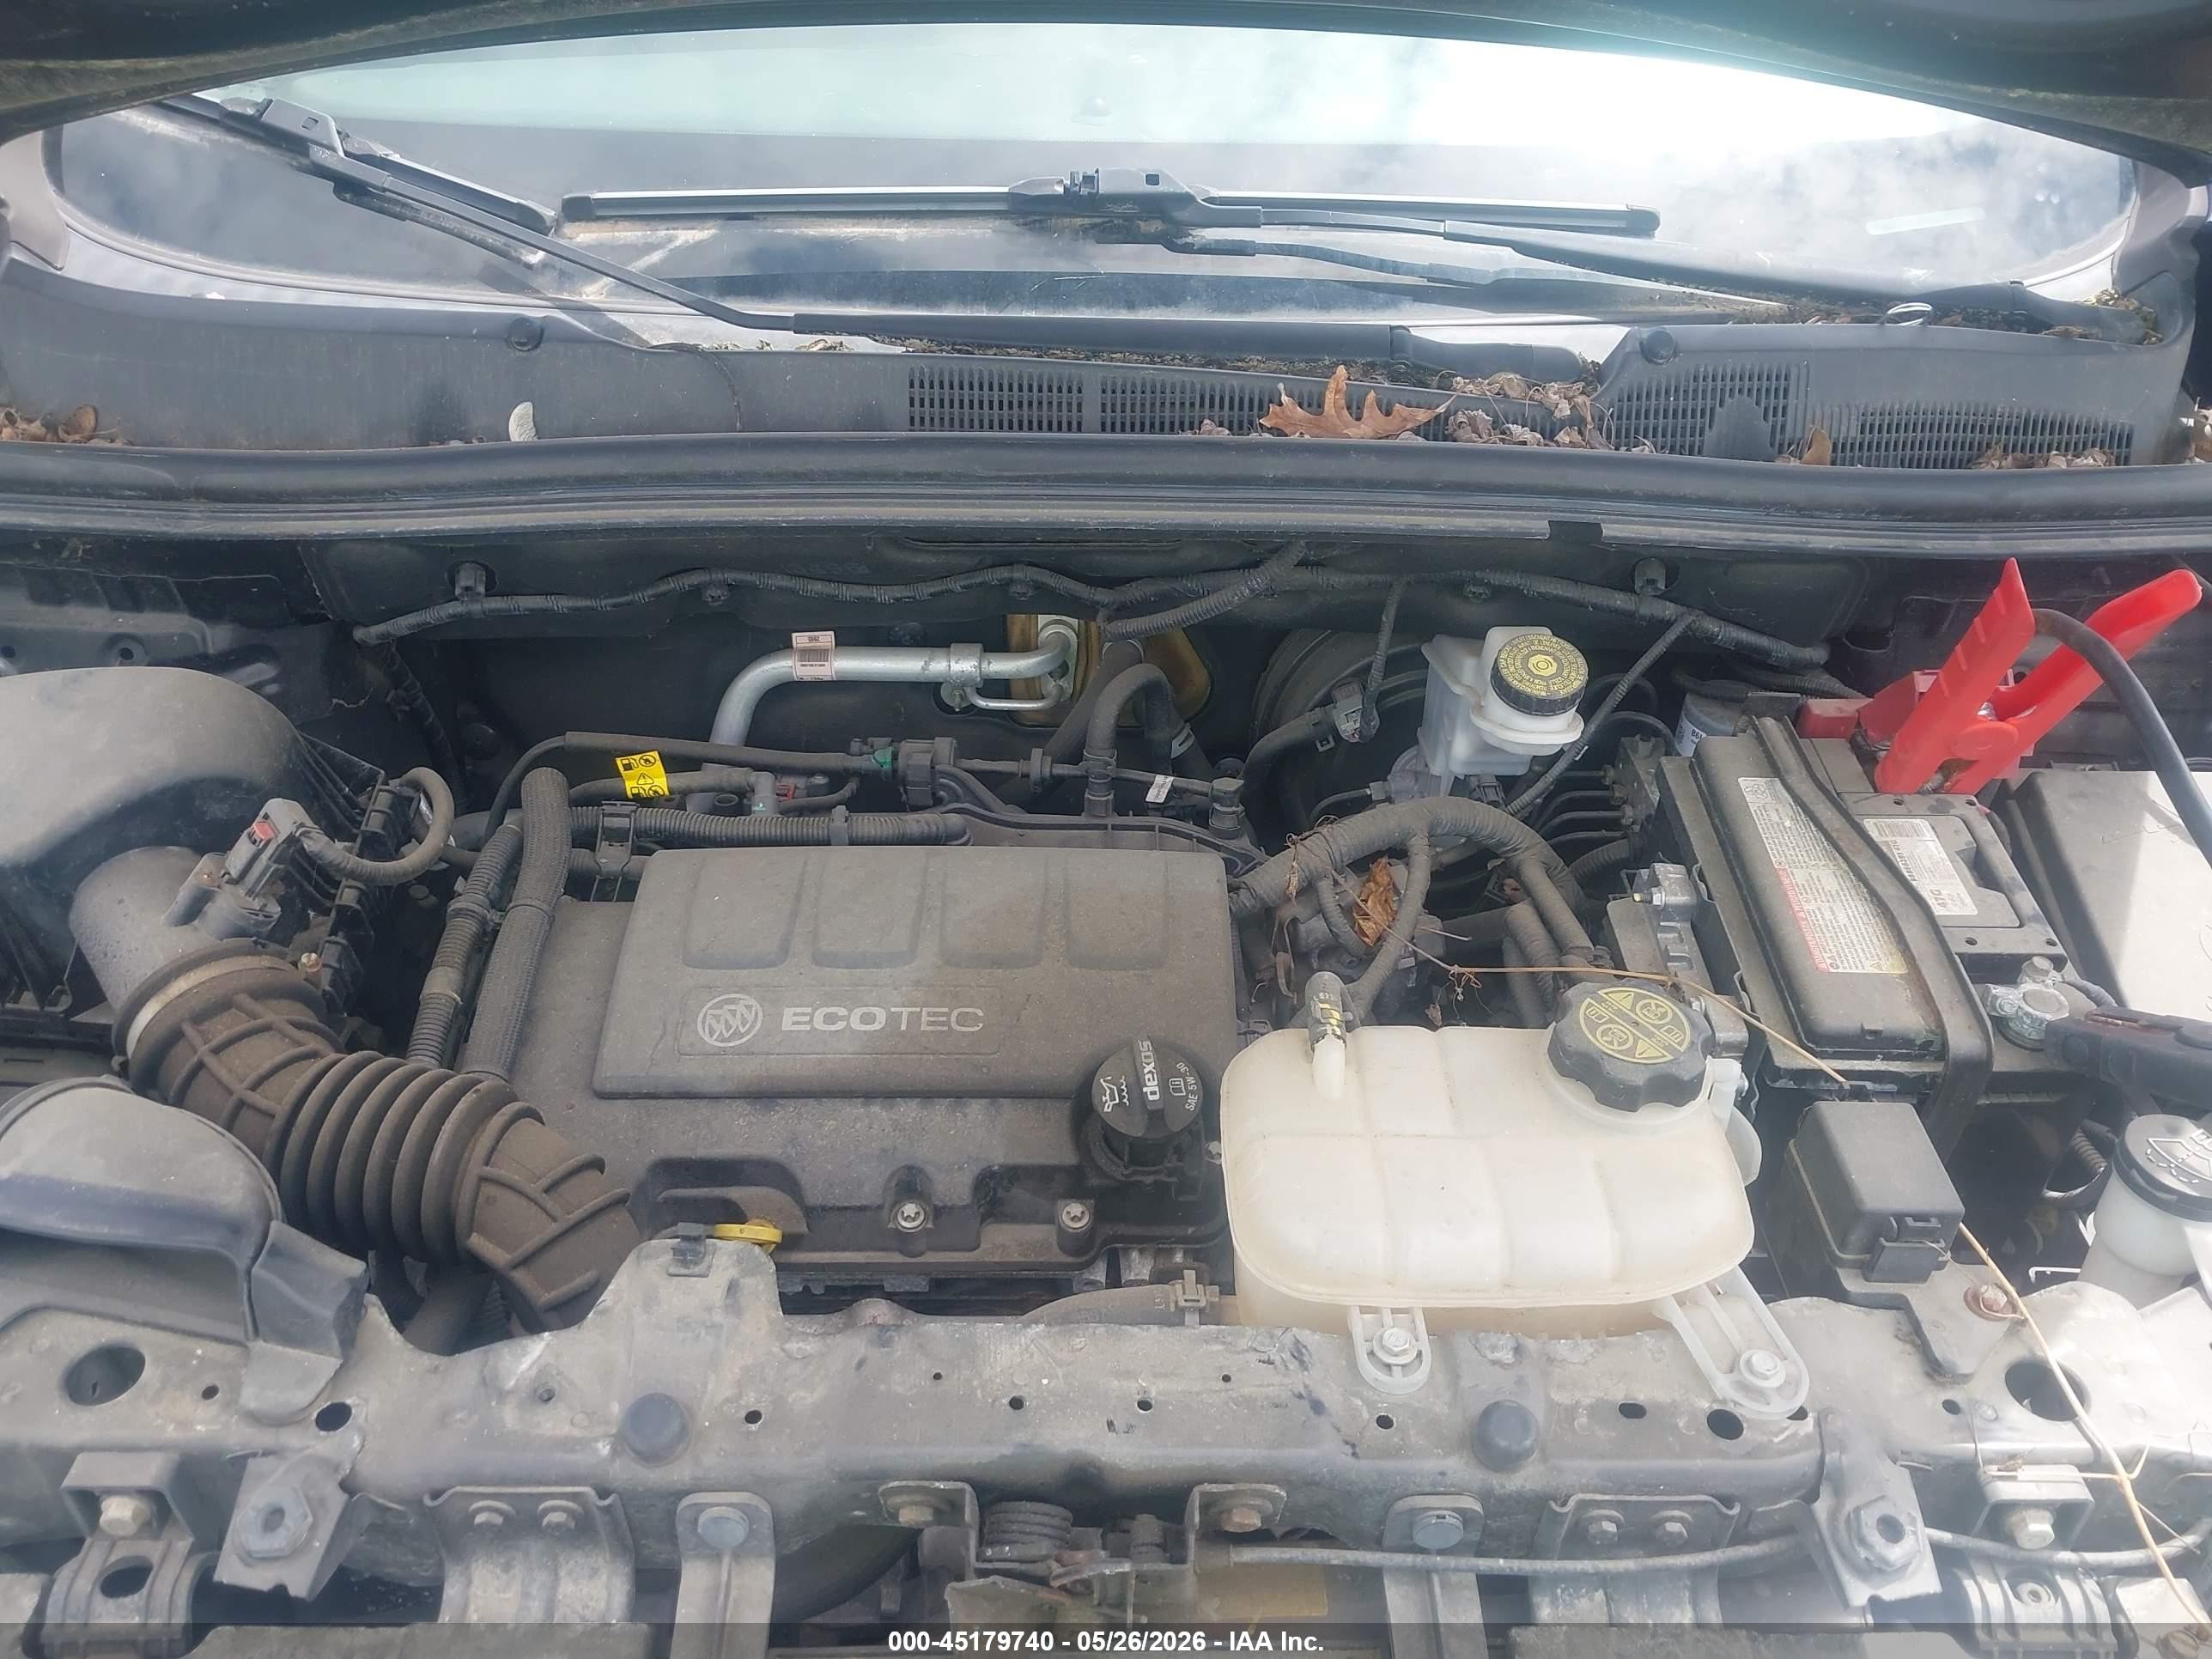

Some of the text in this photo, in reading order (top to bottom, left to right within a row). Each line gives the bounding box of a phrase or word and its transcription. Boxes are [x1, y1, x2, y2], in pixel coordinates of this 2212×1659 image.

[781, 1006, 984, 1031] ECOTEC
[1137, 1038, 1161, 1101] dexos
[1176, 1061, 1199, 1111] SAE 5W-30
